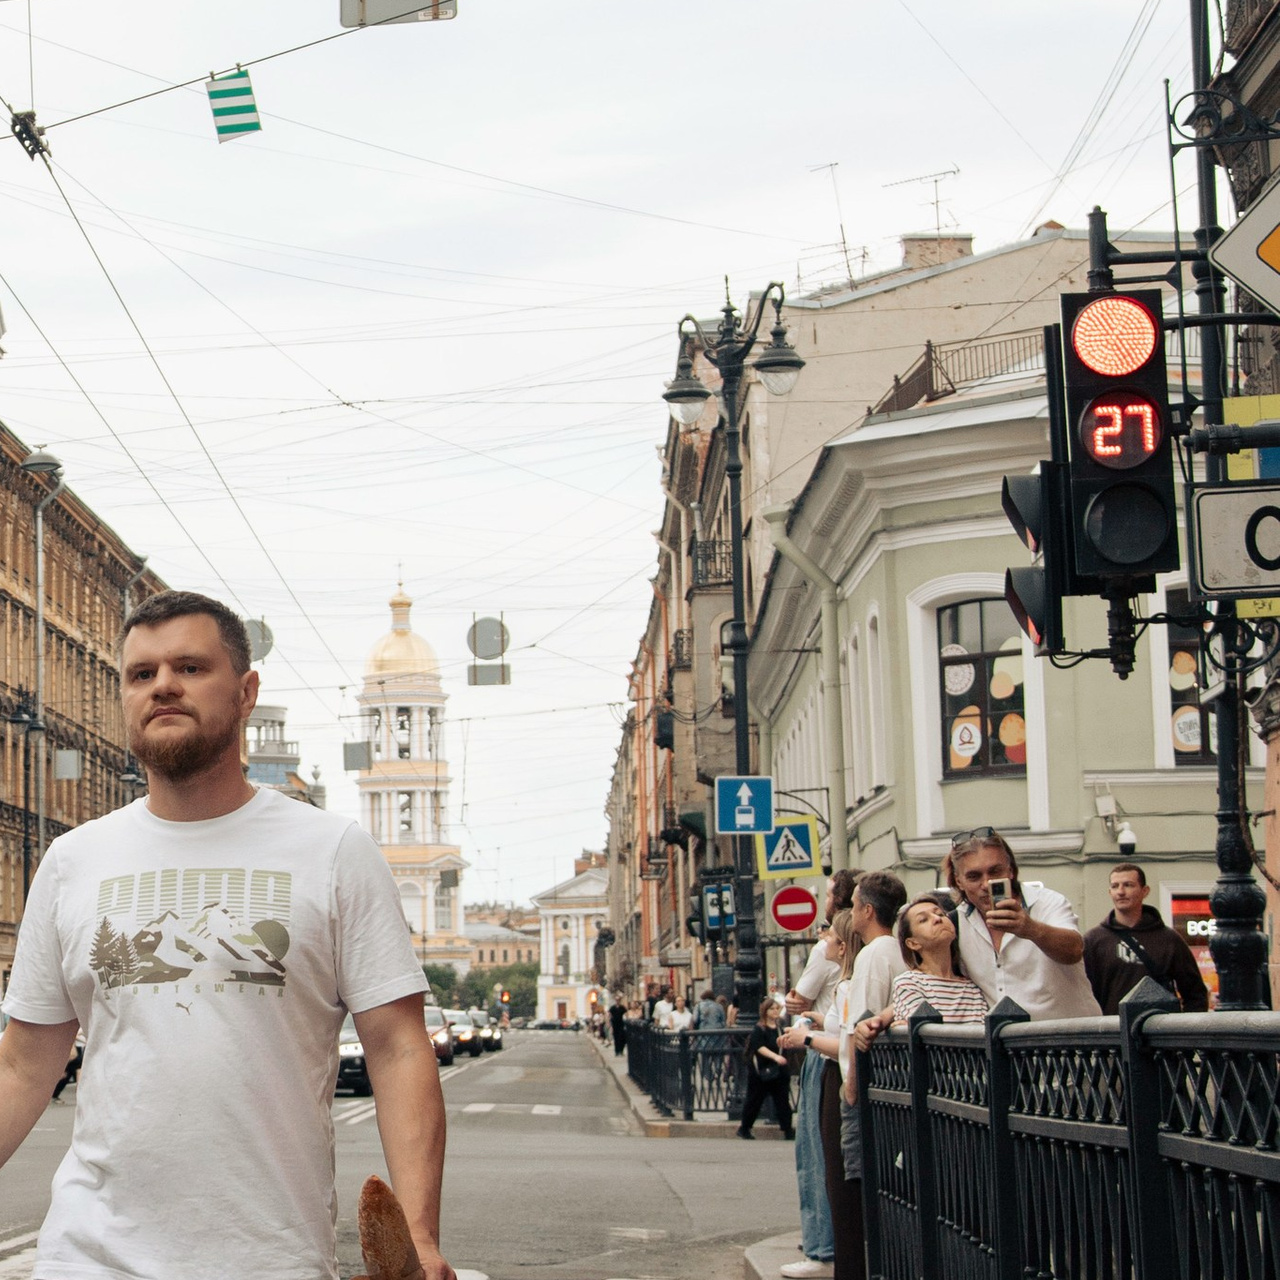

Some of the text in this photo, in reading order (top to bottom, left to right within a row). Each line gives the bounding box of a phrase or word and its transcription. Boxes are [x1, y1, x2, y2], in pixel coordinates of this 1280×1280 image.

[1093, 404, 1154, 456] 27
[96, 868, 292, 927] PUMA
[103, 983, 284, 1000] SORTSWEAR
